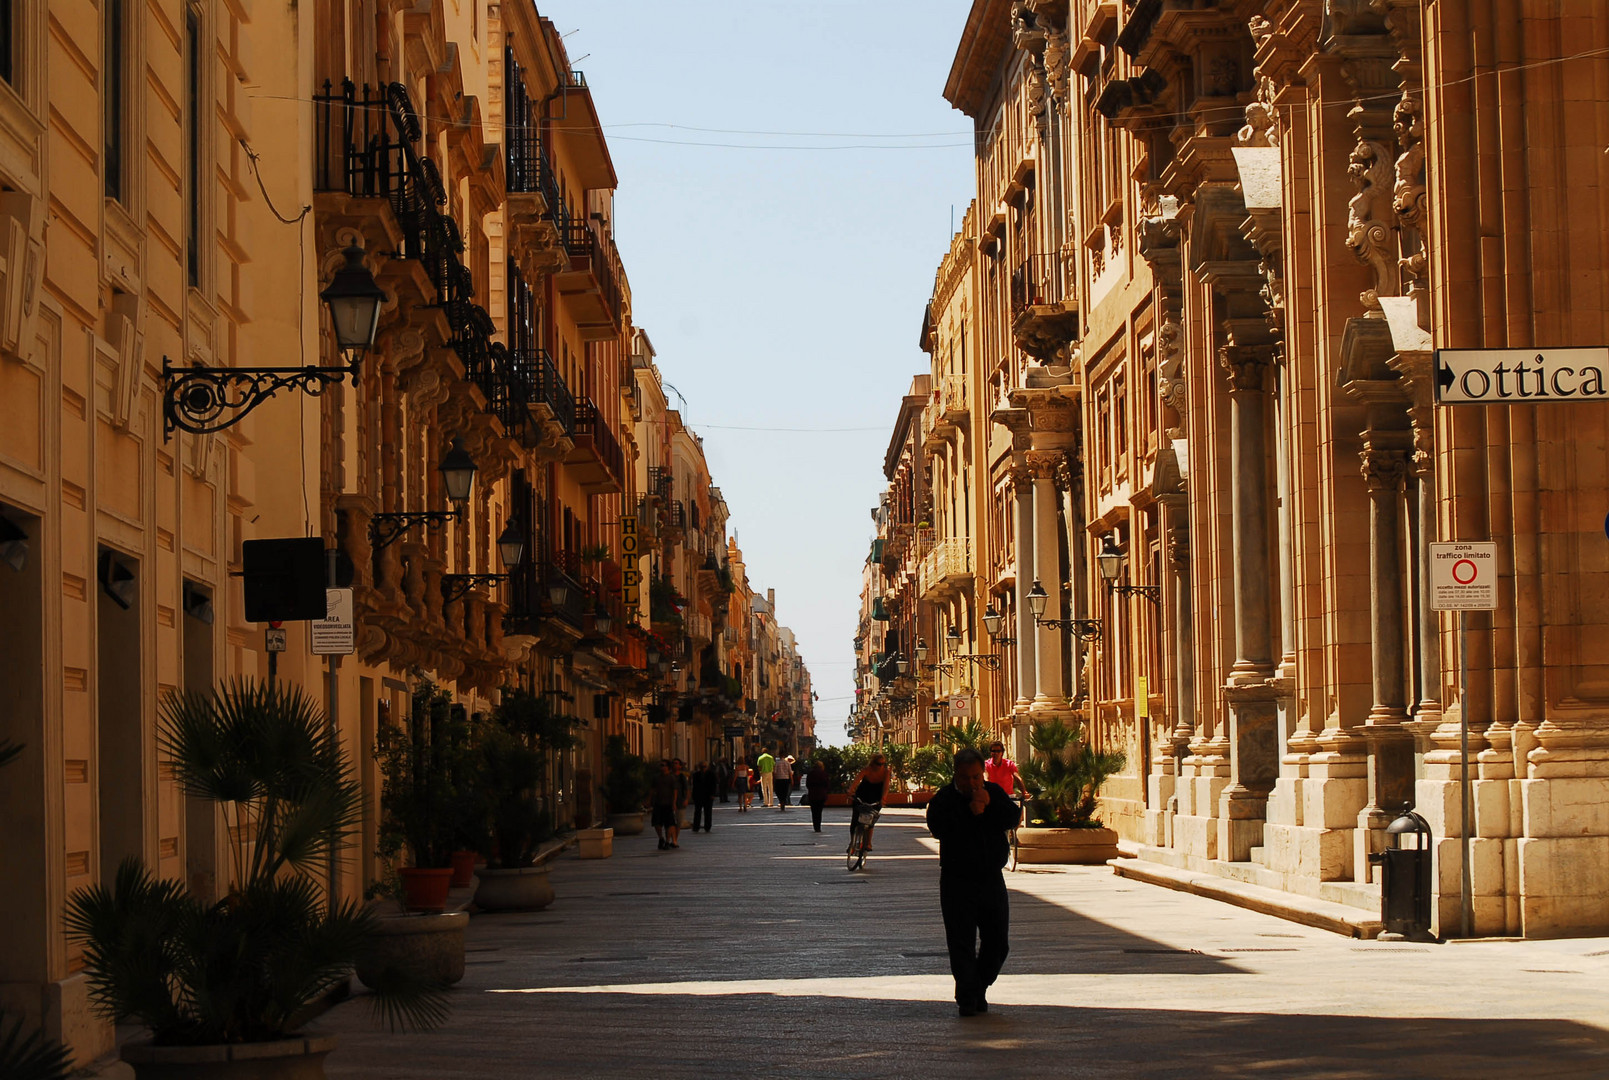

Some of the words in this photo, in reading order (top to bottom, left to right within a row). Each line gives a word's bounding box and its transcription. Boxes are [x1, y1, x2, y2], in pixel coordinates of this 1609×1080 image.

[1460, 353, 1607, 398] ottica
[622, 518, 637, 604] HOTEL
[929, 708, 941, 722] T
